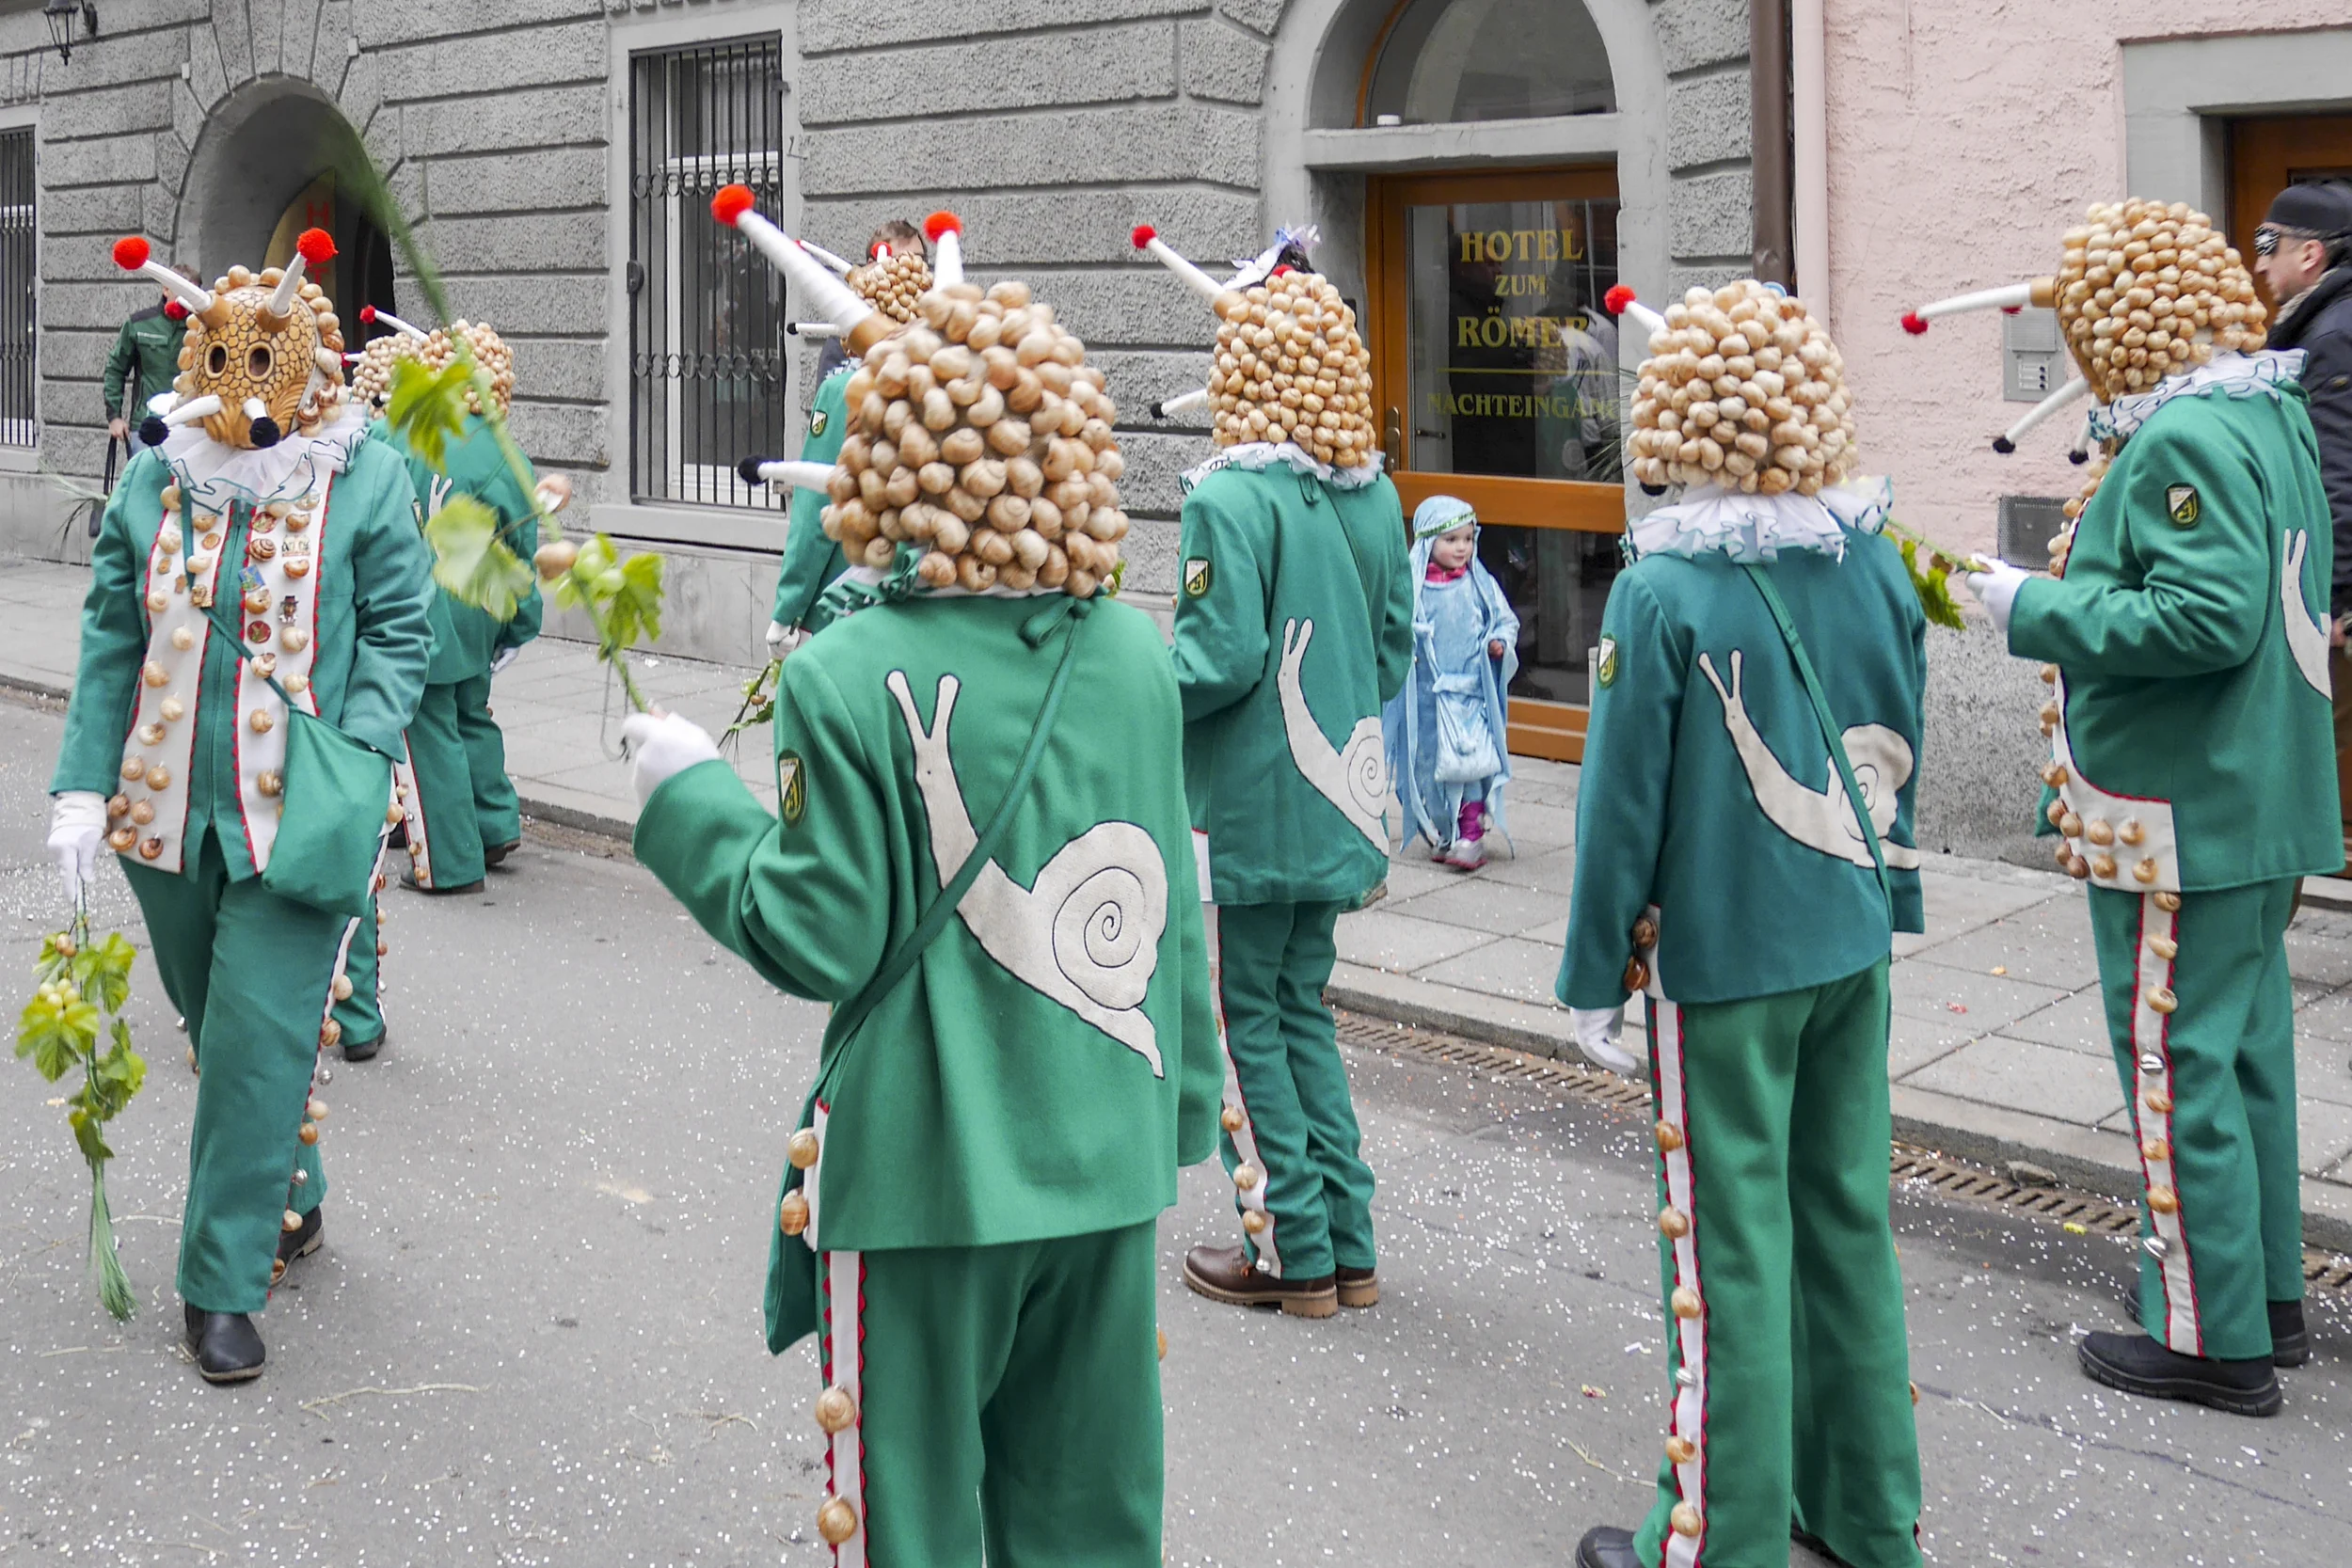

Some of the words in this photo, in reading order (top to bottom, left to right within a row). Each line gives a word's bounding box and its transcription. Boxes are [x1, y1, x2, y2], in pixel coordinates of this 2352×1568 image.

[307, 201, 328, 285] HT
[1461, 230, 1583, 262] HOTEL
[1495, 274, 1546, 296] ZUM
[1457, 307, 1589, 347] RÖMER
